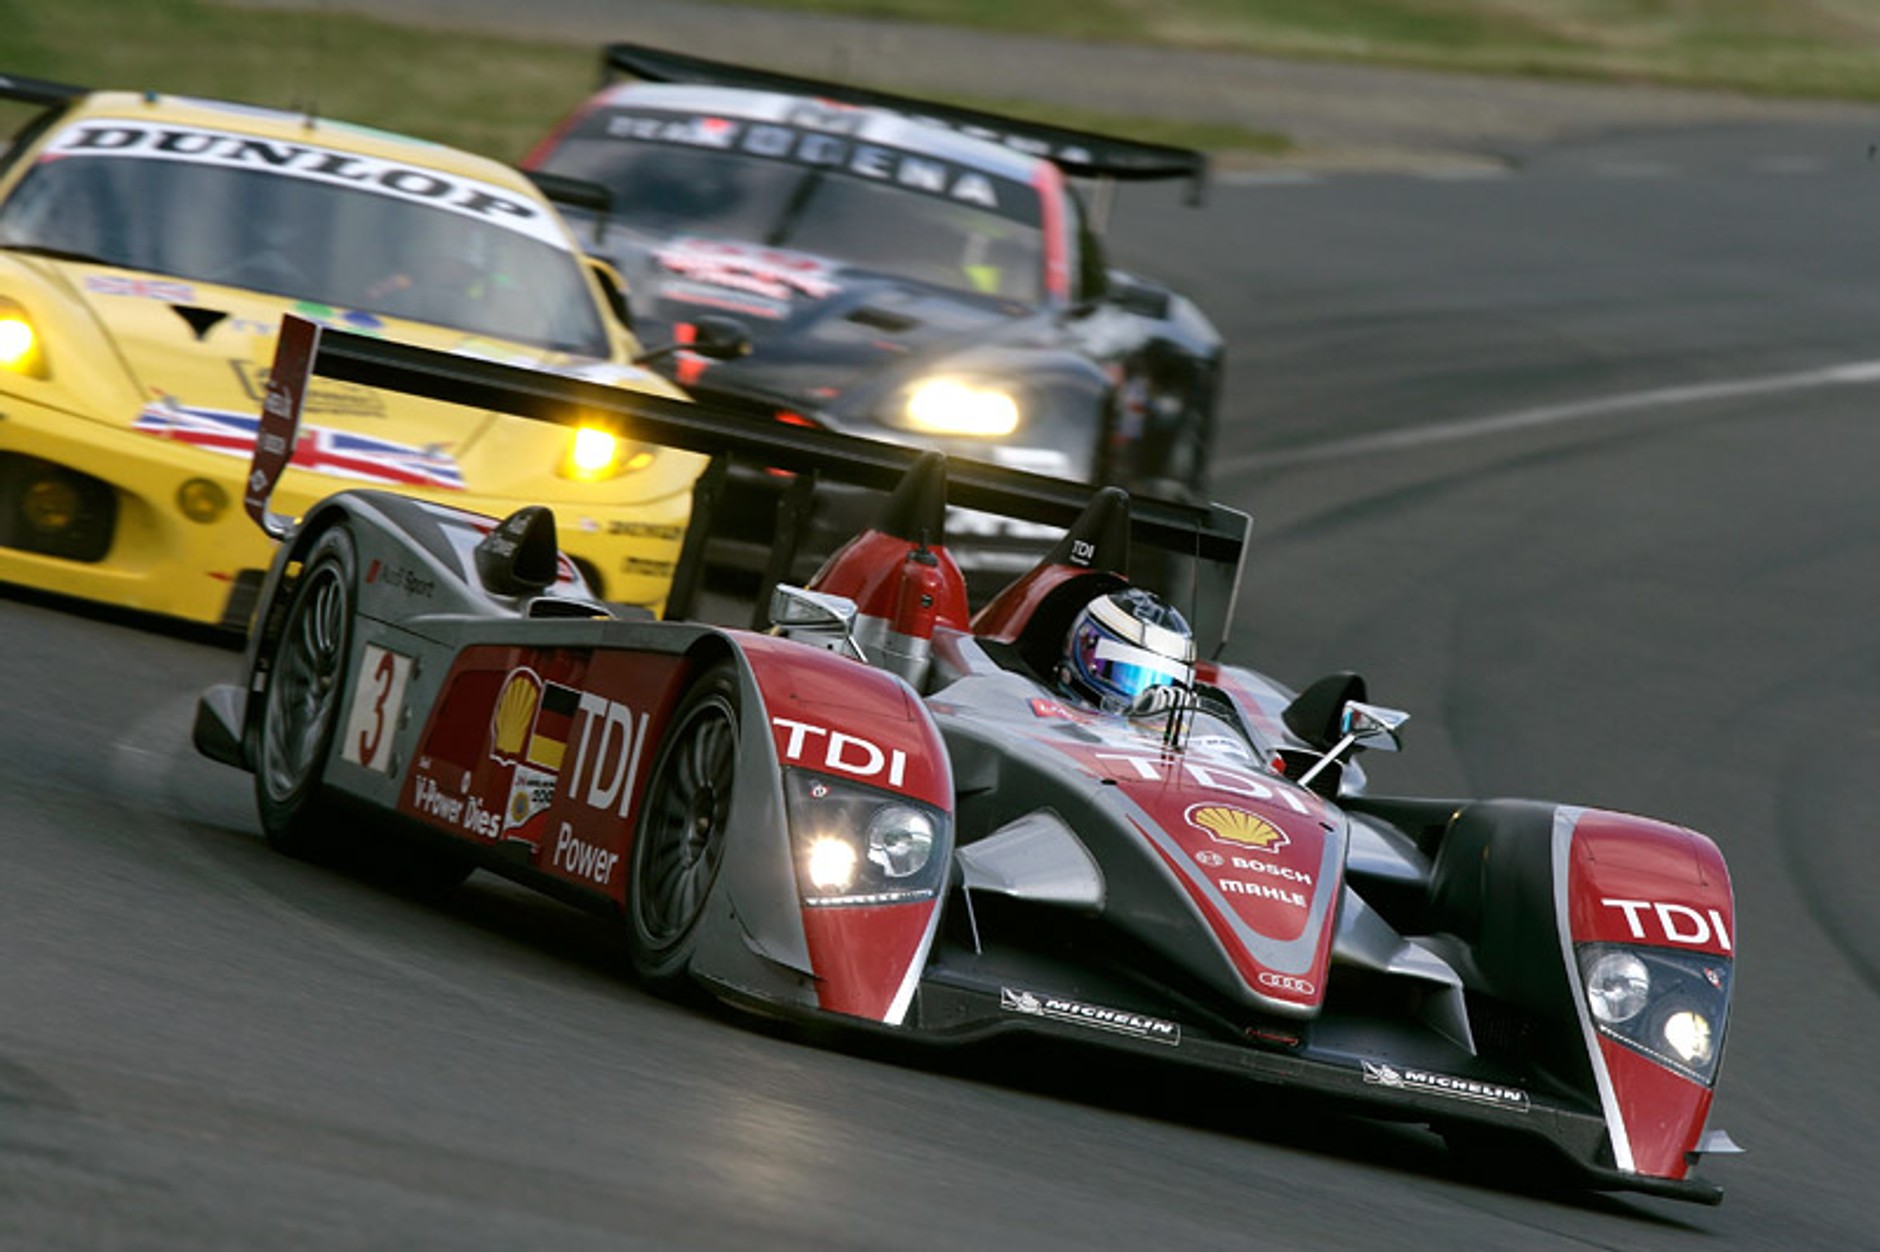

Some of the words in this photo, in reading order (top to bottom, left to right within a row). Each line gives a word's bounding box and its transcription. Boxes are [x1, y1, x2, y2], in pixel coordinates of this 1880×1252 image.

[60, 127, 537, 220] DUNLOP
[1071, 540, 1095, 559] TDI
[404, 569, 434, 598] Sport
[358, 652, 395, 768] 3
[567, 691, 649, 819] TDI
[773, 716, 907, 786] TDI
[414, 774, 464, 824] V-Power
[1094, 752, 1309, 815] TDI
[552, 821, 618, 885] Power
[1231, 855, 1313, 886] BOSCH
[1601, 897, 1731, 951] TDI
[1045, 998, 1174, 1035] MICHELIN
[1405, 1070, 1523, 1102] MICHELIN
